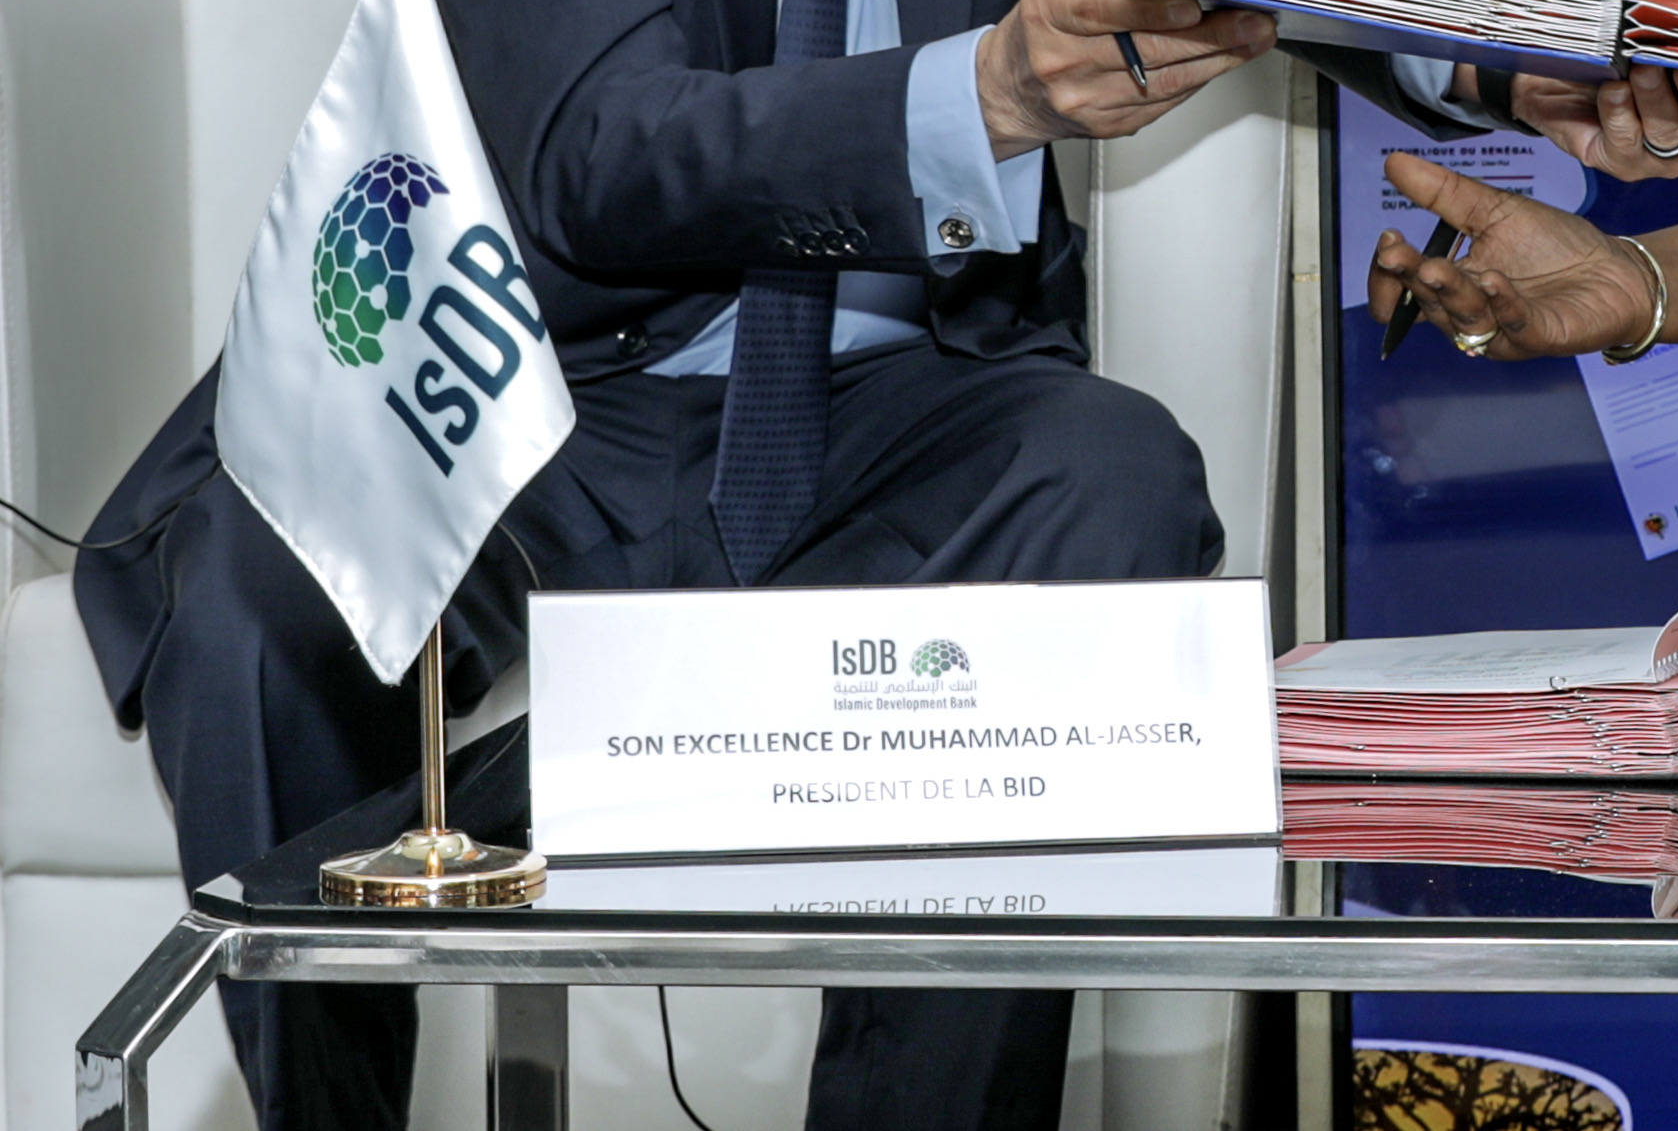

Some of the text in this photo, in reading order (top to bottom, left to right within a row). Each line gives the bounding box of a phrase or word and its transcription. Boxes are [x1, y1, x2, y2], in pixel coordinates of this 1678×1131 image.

[385, 225, 546, 478] IsDB
[832, 638, 897, 675] IsDB
[833, 680, 878, 695] للتنمية
[834, 696, 977, 711] Islamic Development Bank
[607, 722, 1202, 757] SON EXCELLENCE Dr MUHAMMAD AL-JASSER,
[773, 776, 1046, 804] PRESIDENT DE LA BID
